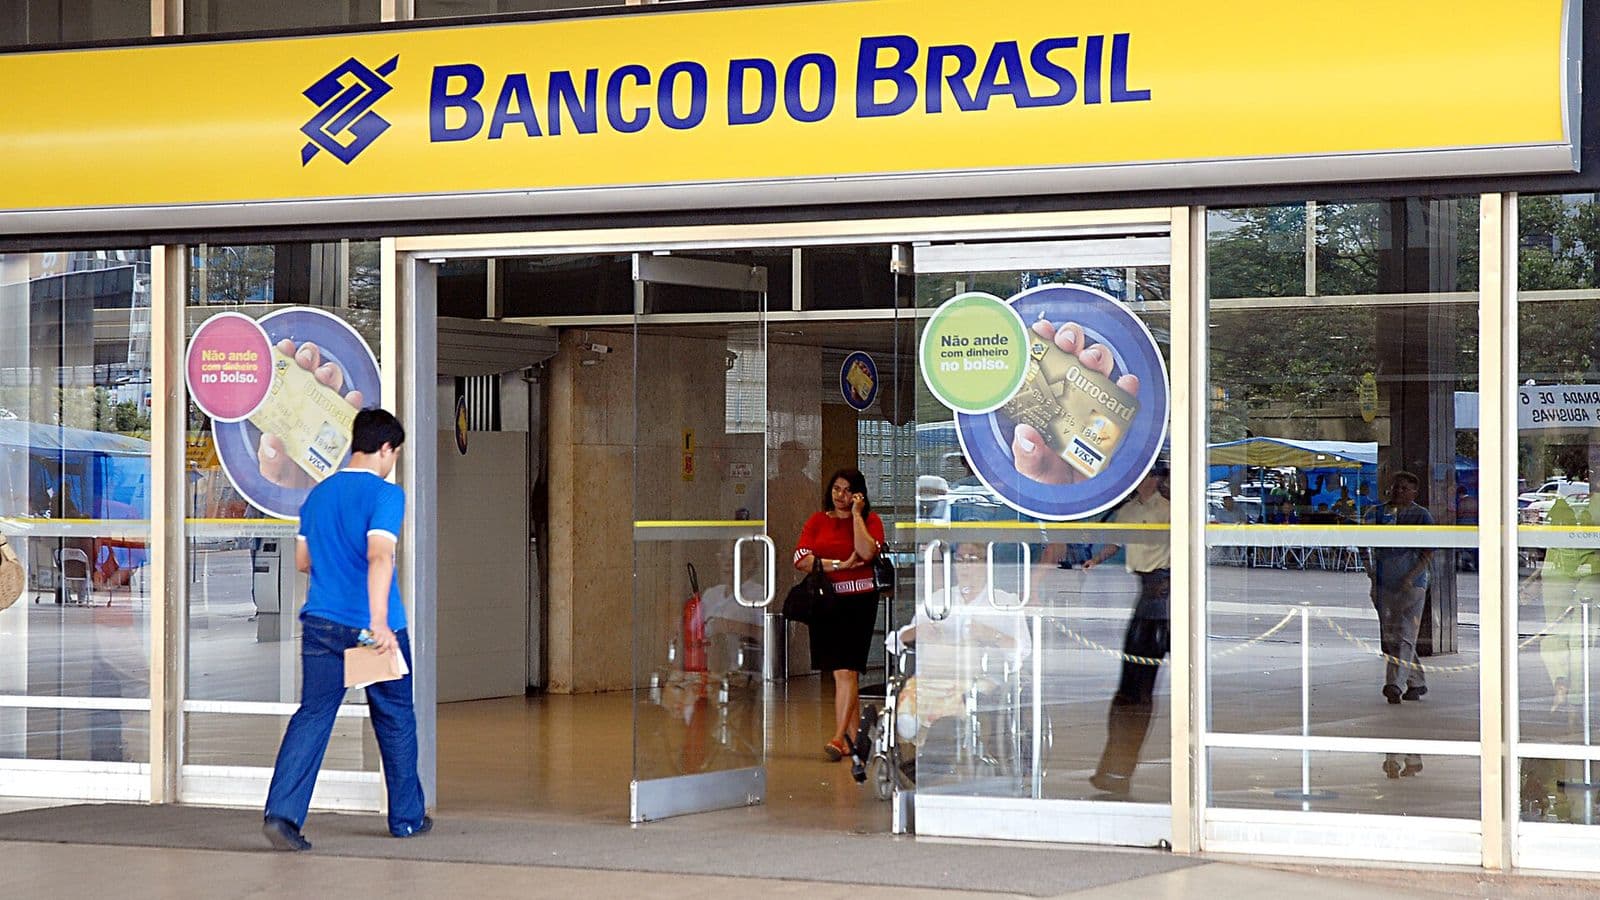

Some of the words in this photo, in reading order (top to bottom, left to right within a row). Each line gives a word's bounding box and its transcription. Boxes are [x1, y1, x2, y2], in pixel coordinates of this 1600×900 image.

[429, 60, 708, 143] BANCO
[727, 53, 836, 126] DO
[855, 32, 1151, 118] BRASIL
[941, 335, 969, 347] Não
[973, 334, 1009, 346] ande
[202, 350, 226, 361] Não
[229, 350, 258, 361] ande
[941, 350, 963, 358] com
[966, 347, 1009, 357] dinheiro
[222, 362, 258, 371] dinheiro
[941, 361, 960, 371] no
[963, 358, 1009, 370] bolso.
[202, 374, 218, 383] no
[220, 371, 258, 383] bolso.
[1066, 366, 1136, 421] Ourocard
[1074, 446, 1095, 466] VISA
[308, 455, 326, 473] VISA
